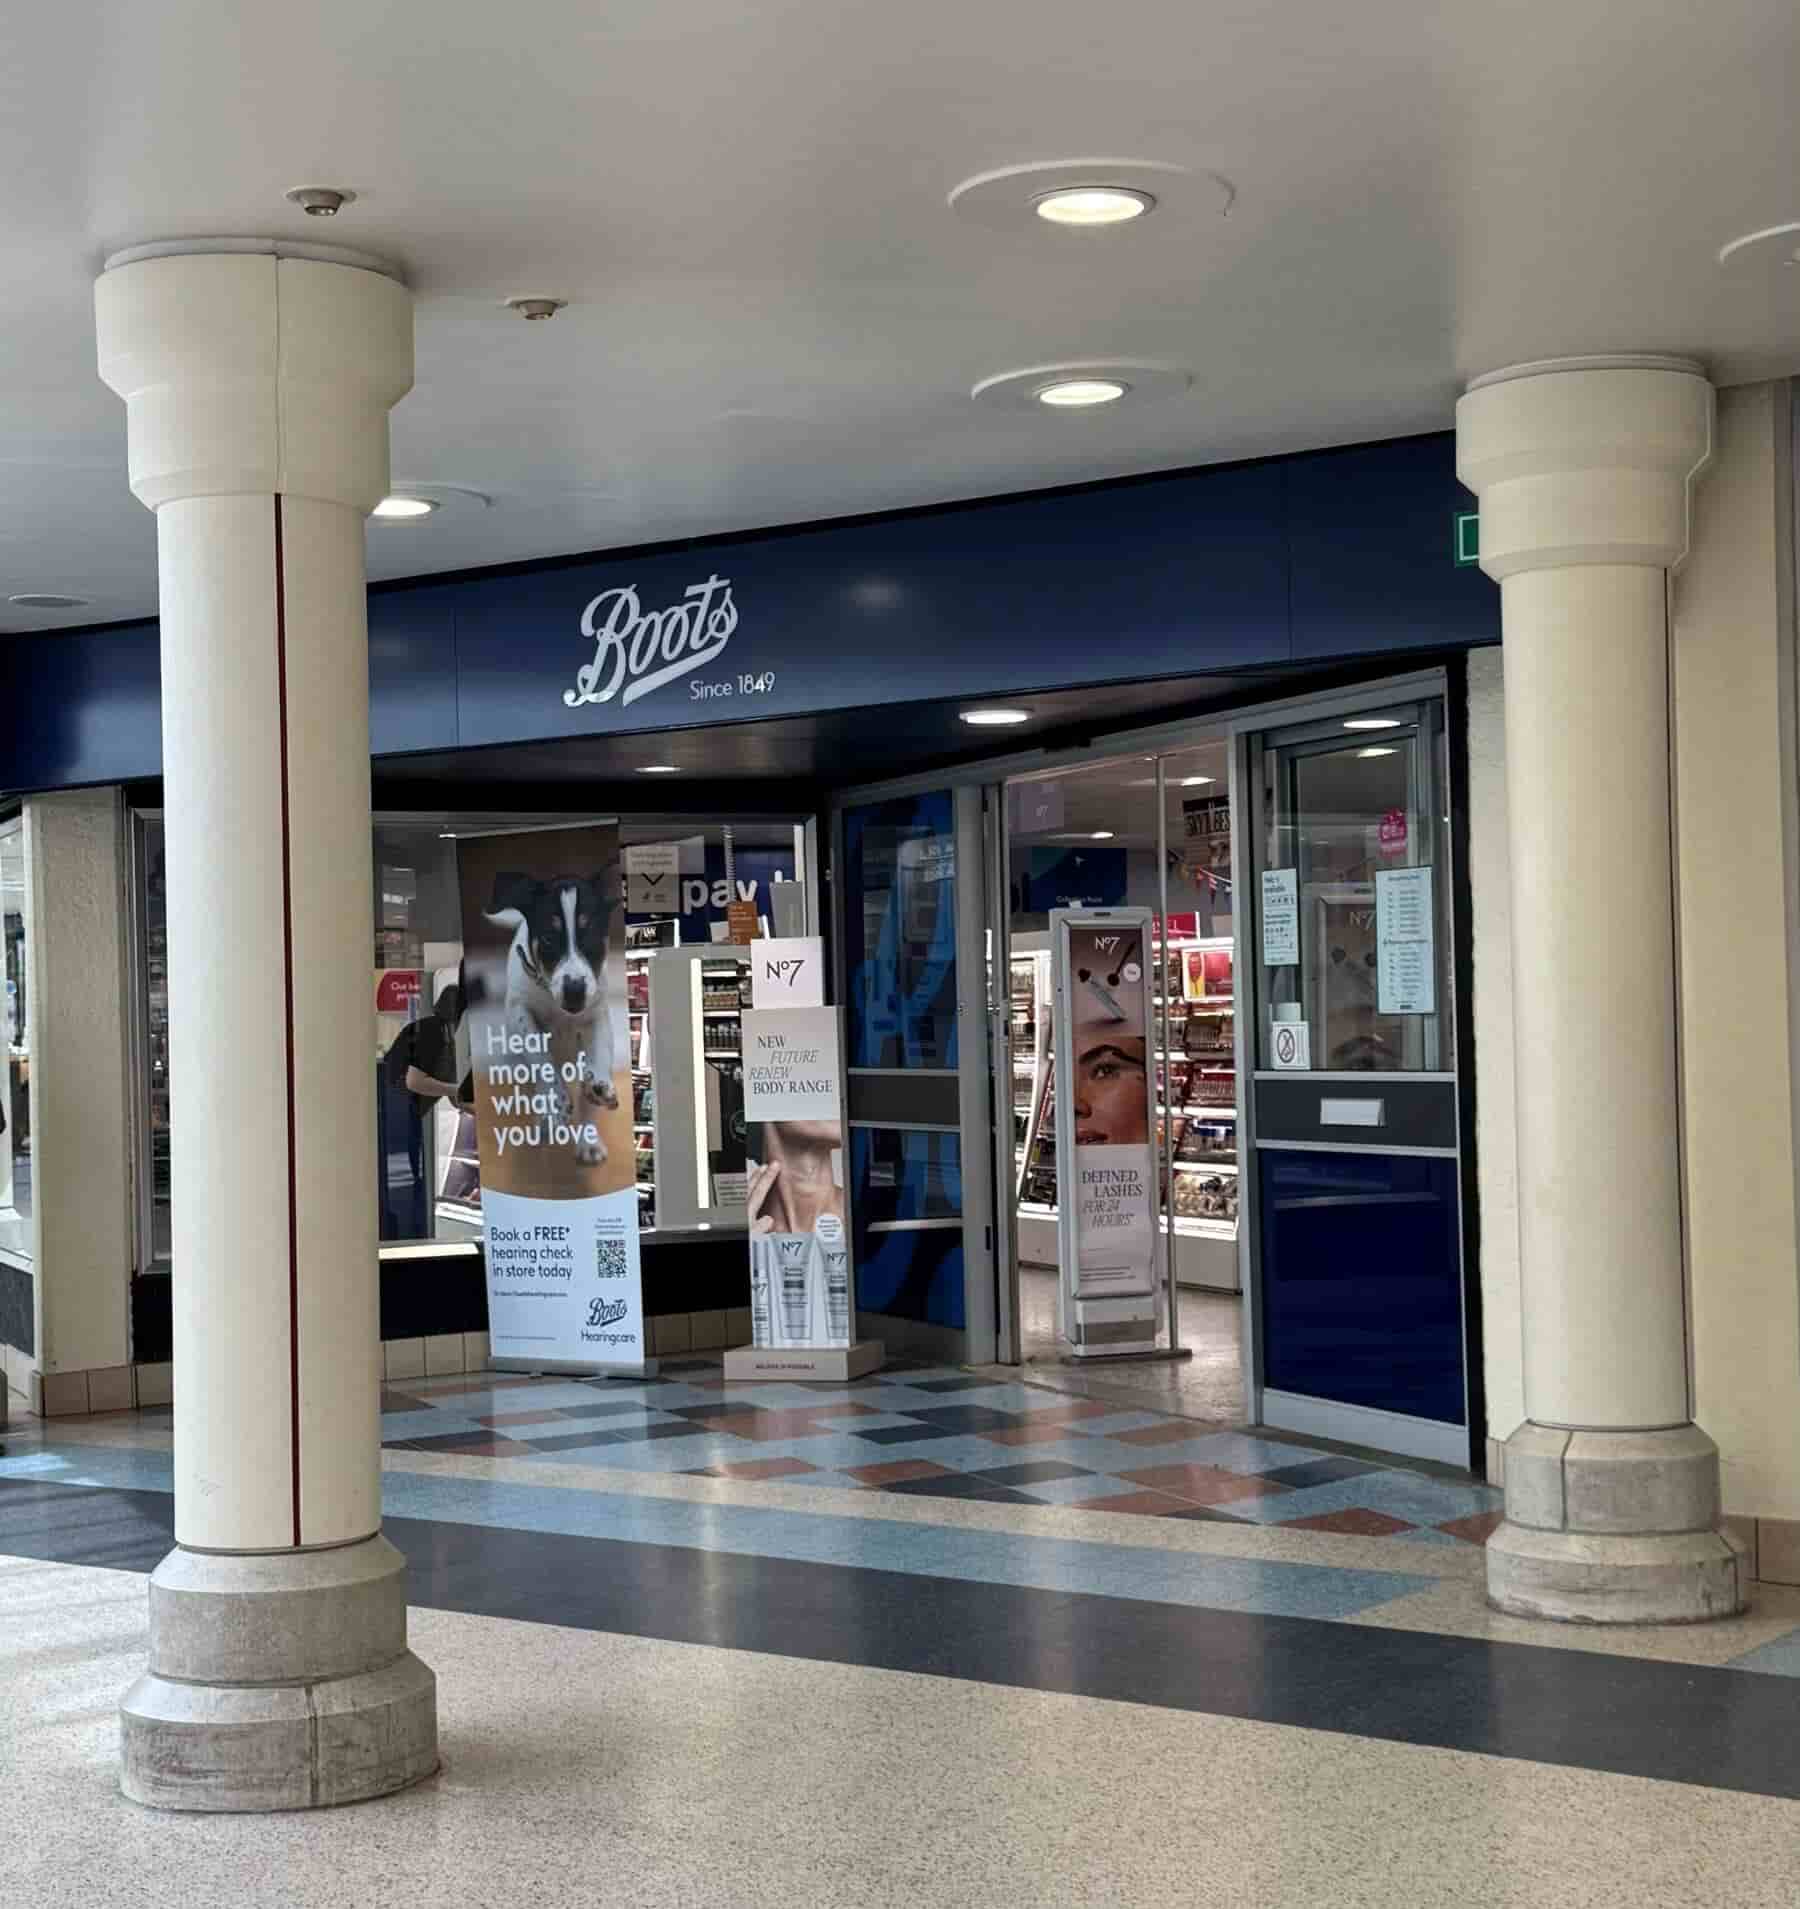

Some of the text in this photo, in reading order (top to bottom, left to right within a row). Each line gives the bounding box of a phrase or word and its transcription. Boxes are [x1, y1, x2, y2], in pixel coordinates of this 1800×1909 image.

[564, 574, 738, 706] Boots
[690, 671, 776, 700] Since 1849
[487, 1025, 552, 1056] Hear
[758, 1034, 786, 1049] NEW
[770, 1050, 819, 1065] FUTURE
[489, 1051, 586, 1085] more of
[749, 1066, 792, 1081] RENEW
[753, 1079, 832, 1095] BODY RANGE
[491, 1085, 560, 1117] what
[494, 1115, 599, 1156] you love
[1082, 1169, 1138, 1184] DEFINED
[1095, 1184, 1143, 1198] LASHES
[1084, 1200, 1105, 1213] FOR
[491, 1227, 520, 1241] Book
[523, 1231, 531, 1241] a
[492, 1245, 573, 1262] hearing check
[493, 1264, 573, 1281] in store today
[586, 1296, 627, 1327] Boots
[581, 1329, 636, 1345] Hearingcare
